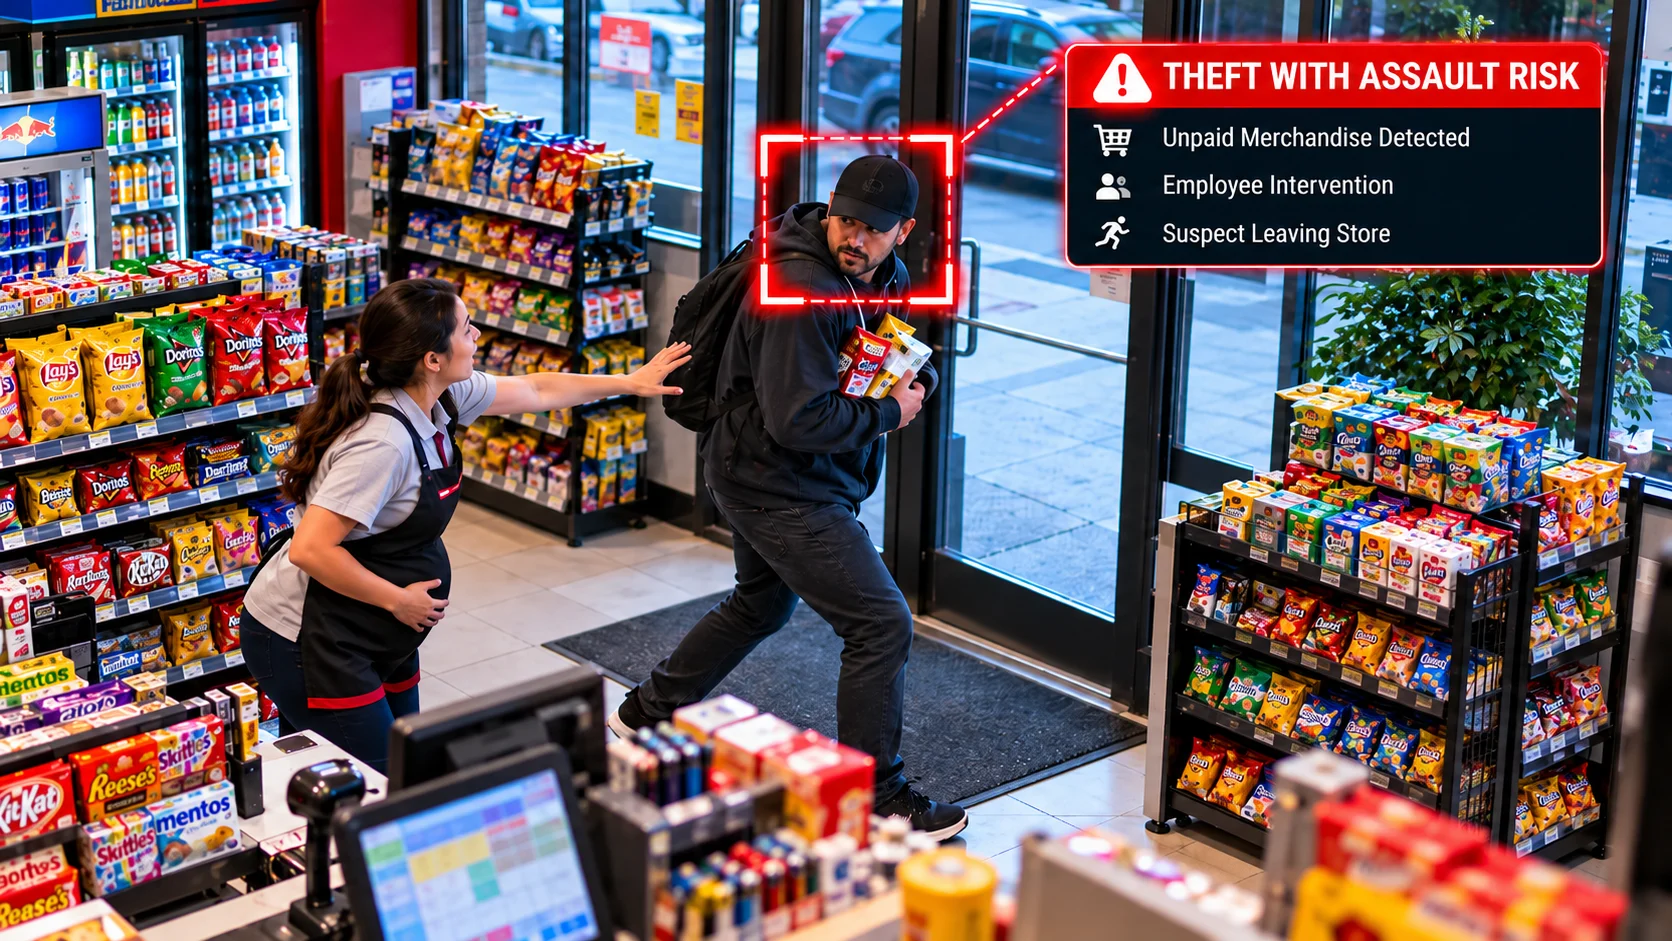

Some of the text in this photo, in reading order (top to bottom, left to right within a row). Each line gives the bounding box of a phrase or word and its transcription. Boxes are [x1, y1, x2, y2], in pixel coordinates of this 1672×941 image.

[45, 361, 78, 384] Lay's
[109, 350, 141, 375] Lay's
[157, 732, 212, 772] Skittles
[87, 765, 157, 803] Reese's
[156, 796, 231, 833] mentos
[96, 828, 156, 867] Skittles
